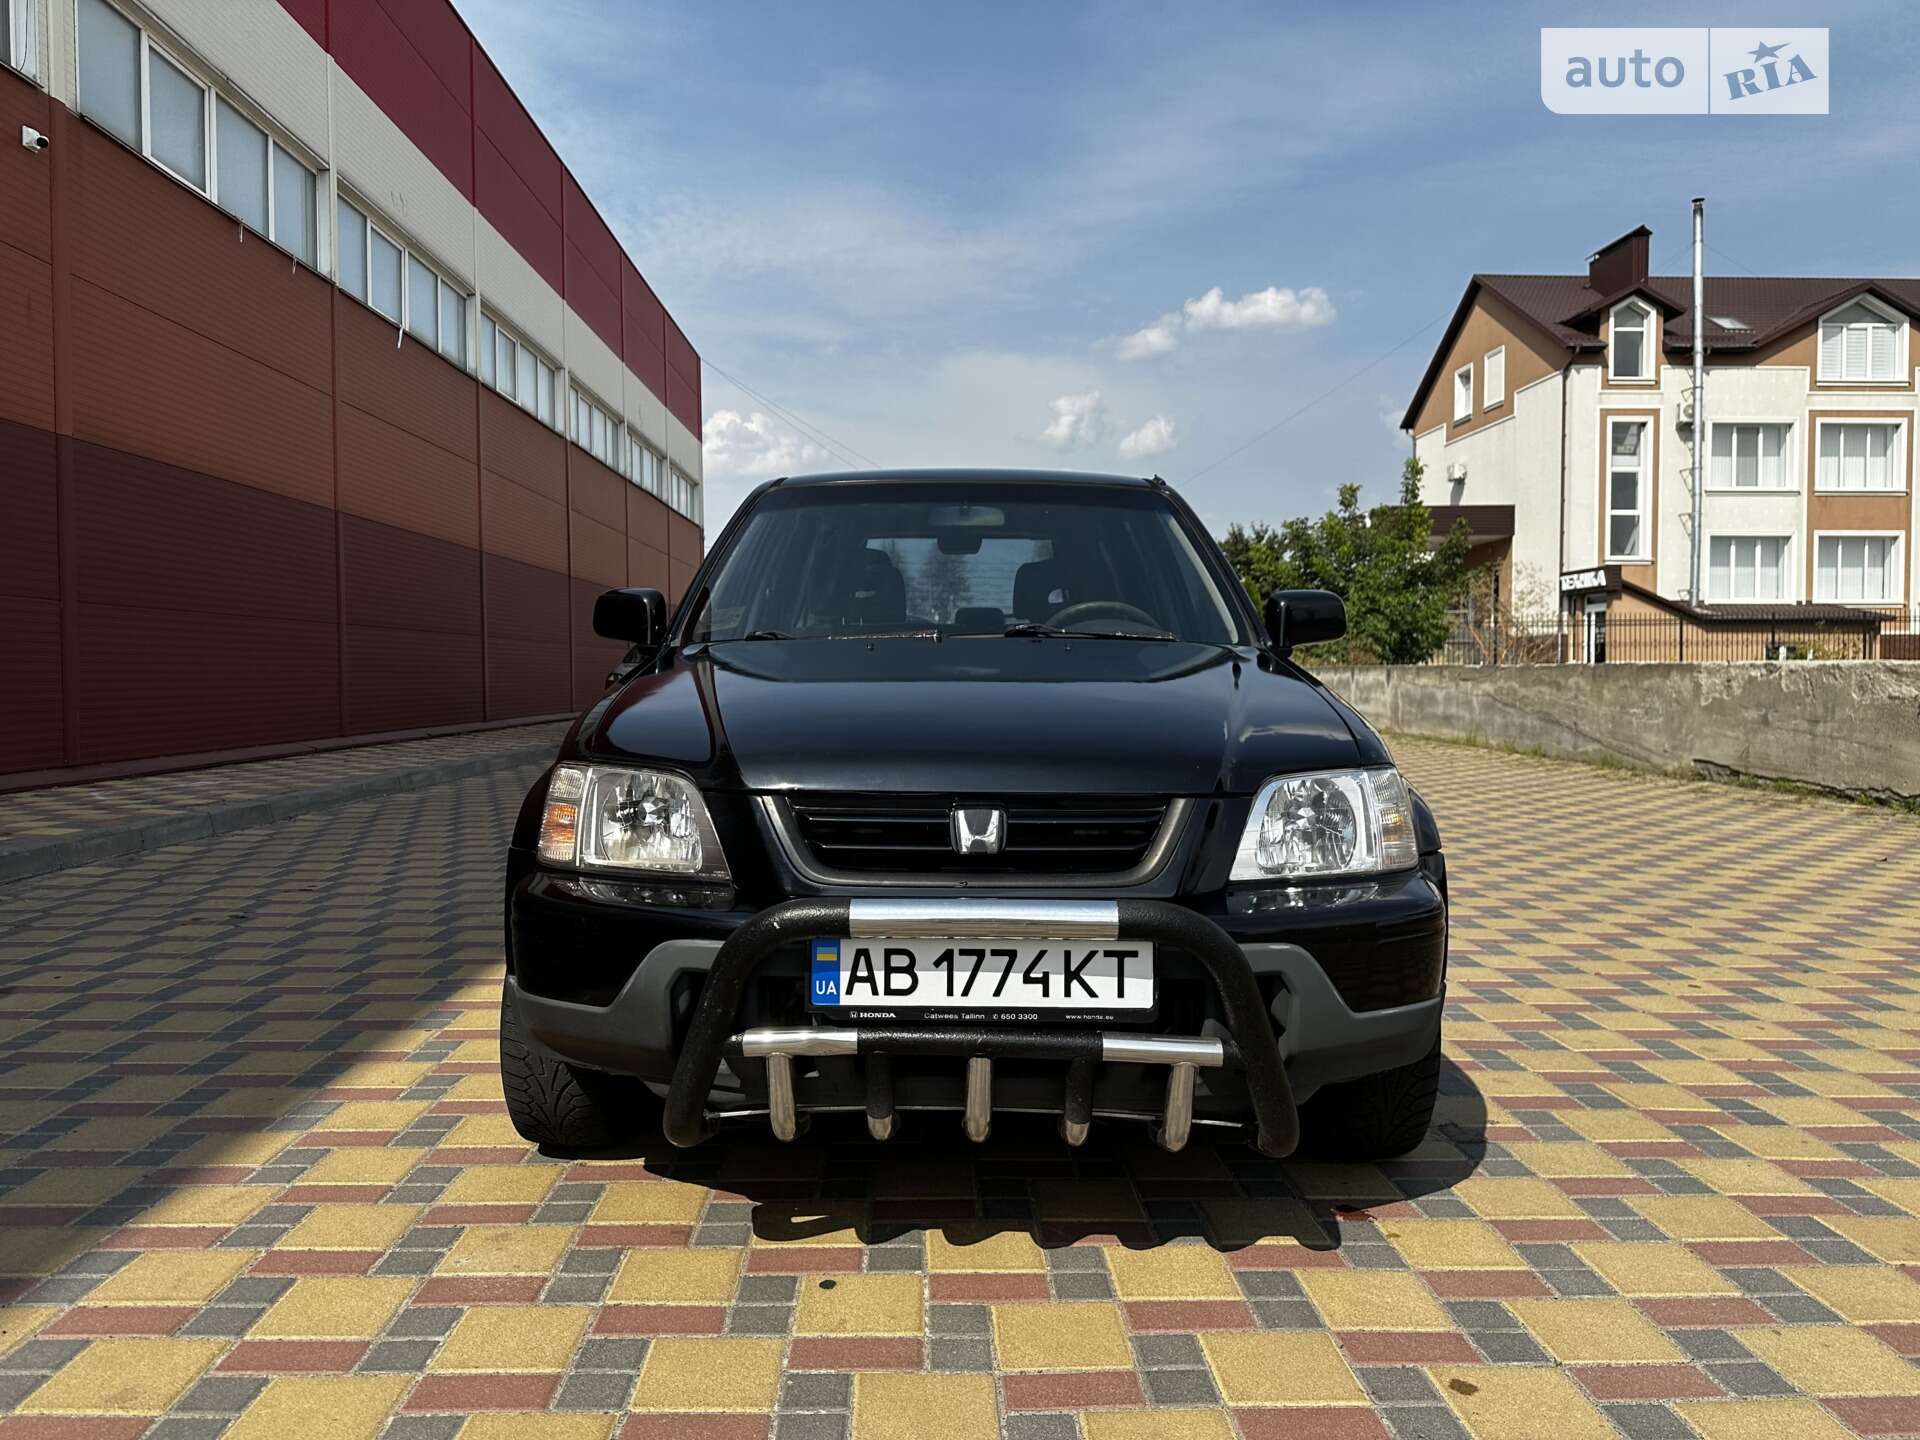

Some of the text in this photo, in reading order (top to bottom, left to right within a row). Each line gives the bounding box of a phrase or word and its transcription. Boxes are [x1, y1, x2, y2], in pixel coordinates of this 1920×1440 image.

[845, 947, 1139, 999] AB 1774 KT
[815, 980, 838, 995] UA
[961, 1012, 986, 1020] Tallinn
[1017, 1013, 1038, 1021] 3300
